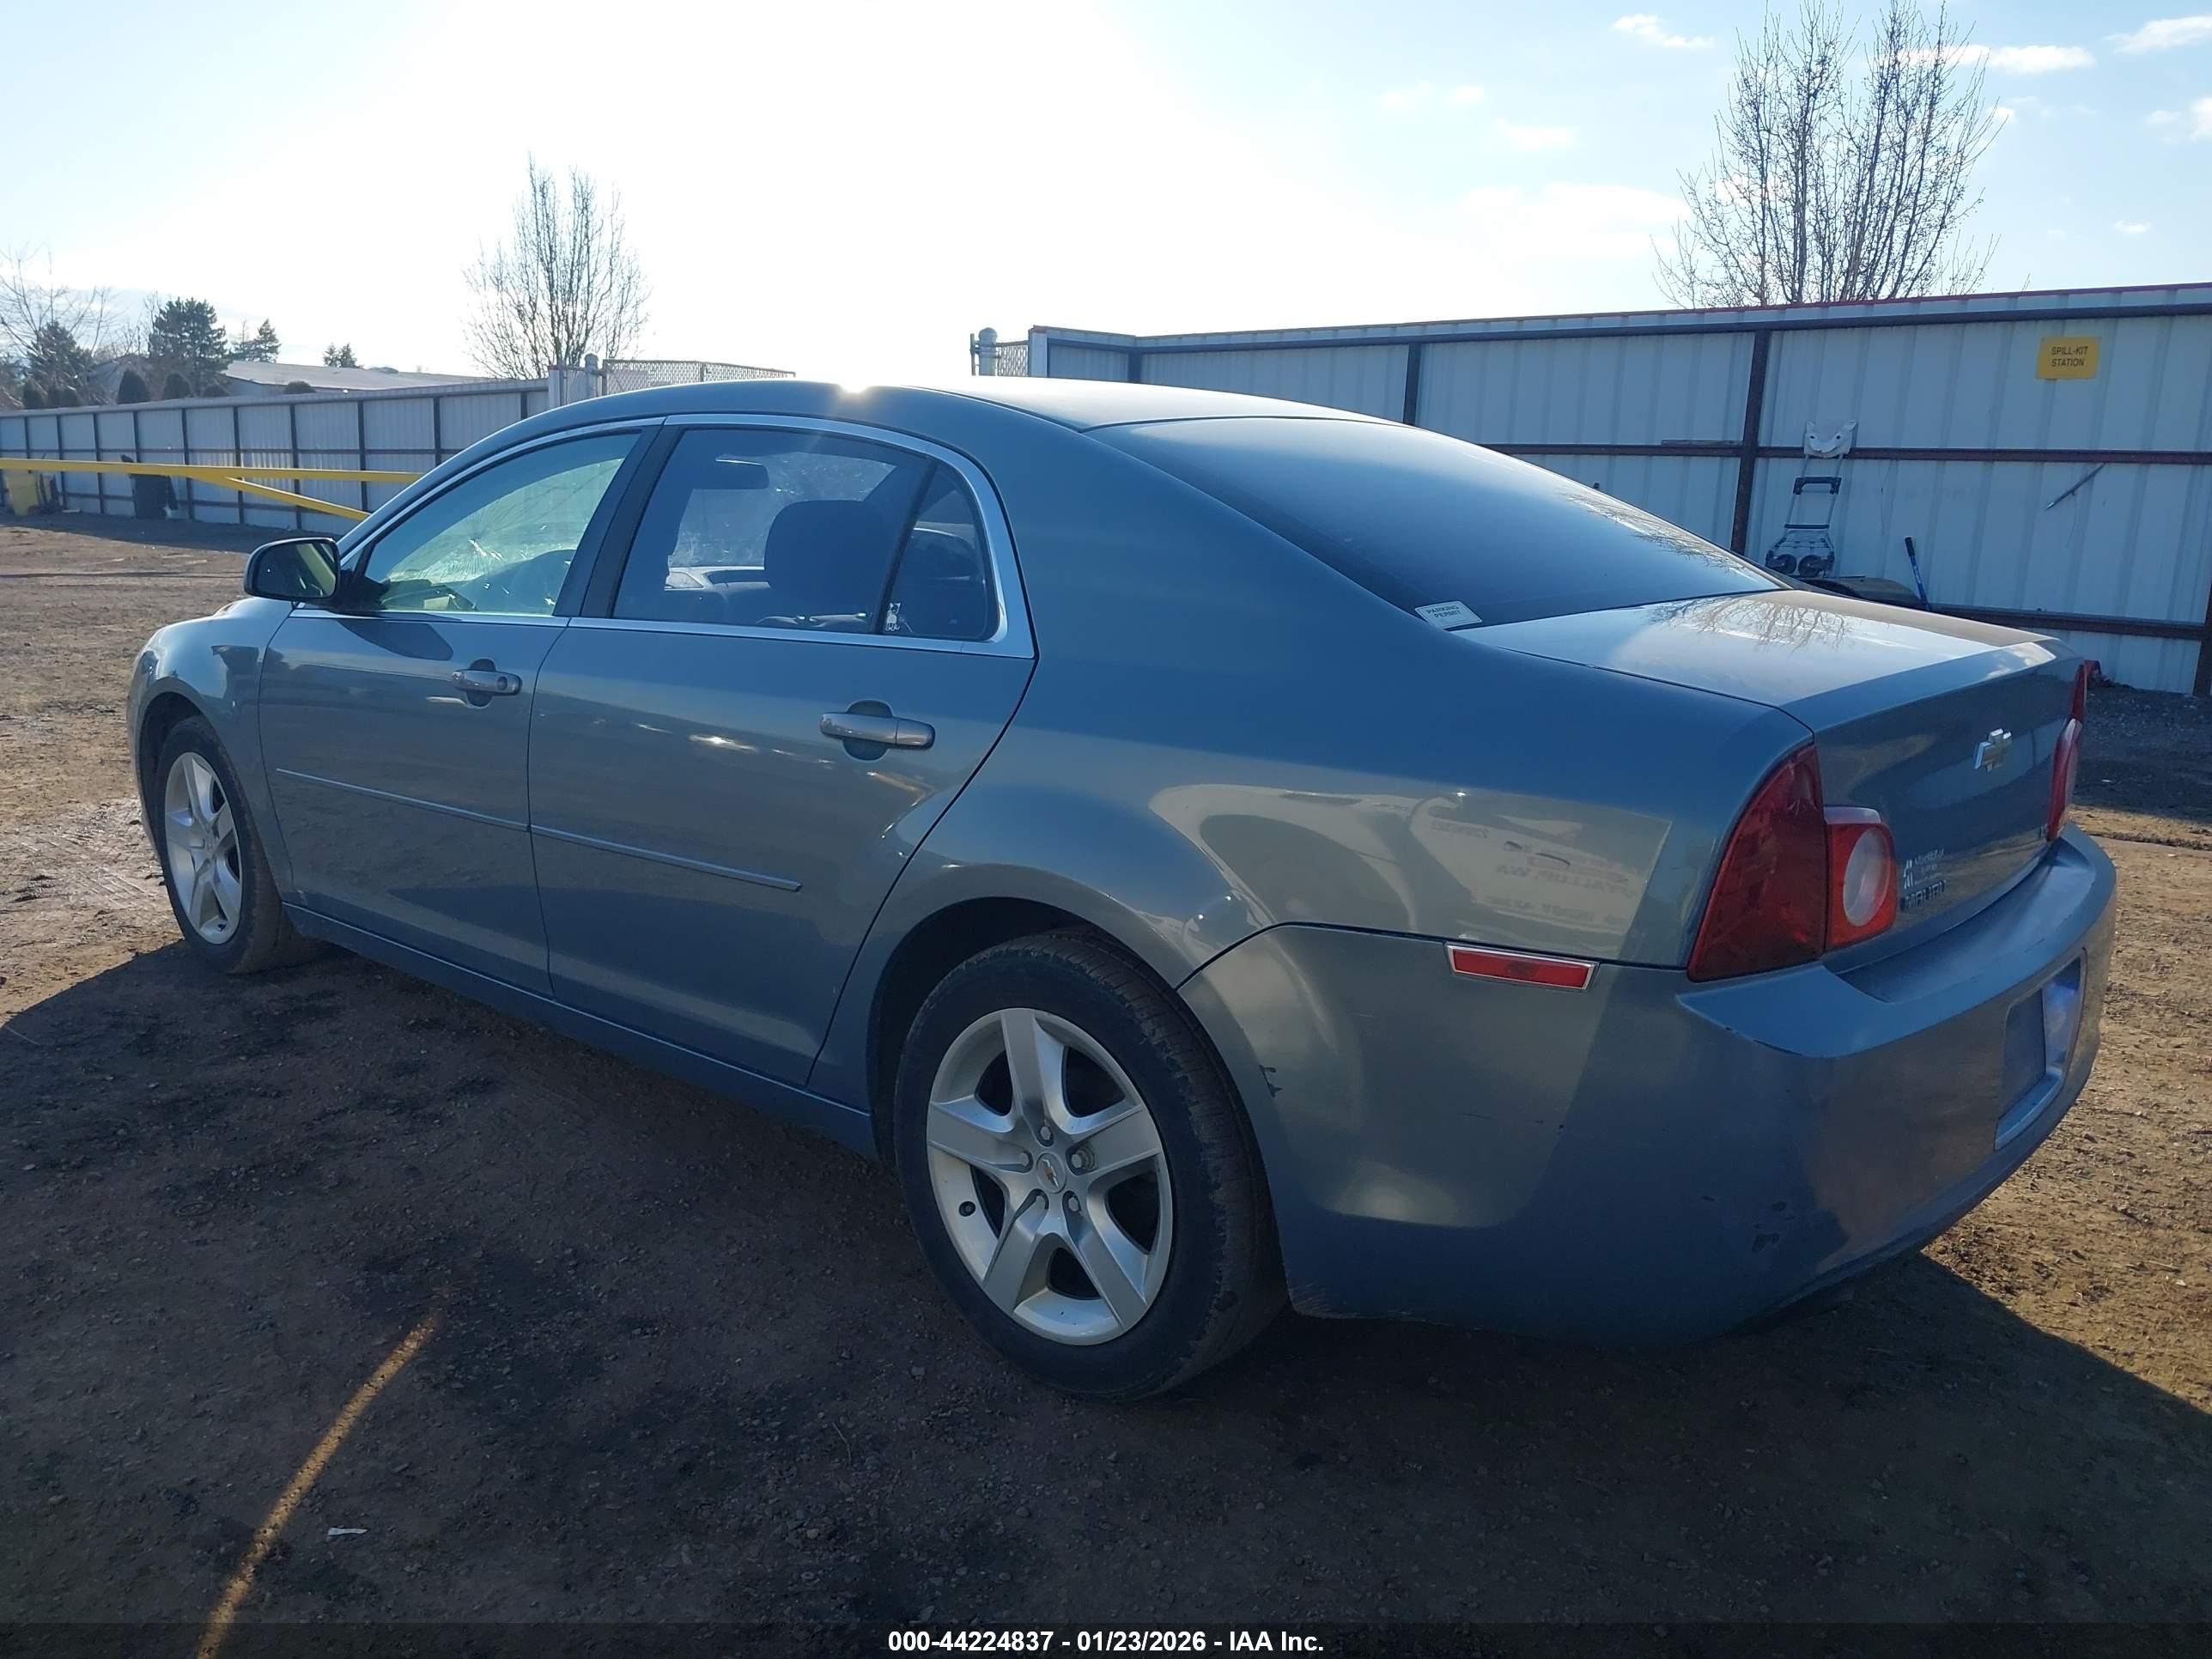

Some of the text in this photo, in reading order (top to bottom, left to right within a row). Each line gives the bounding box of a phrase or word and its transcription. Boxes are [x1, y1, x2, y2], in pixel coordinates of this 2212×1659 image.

[2051, 346, 2088, 356] SPILL-KIT
[2051, 357, 2085, 368] STATION
[1425, 605, 1459, 614] PARKING
